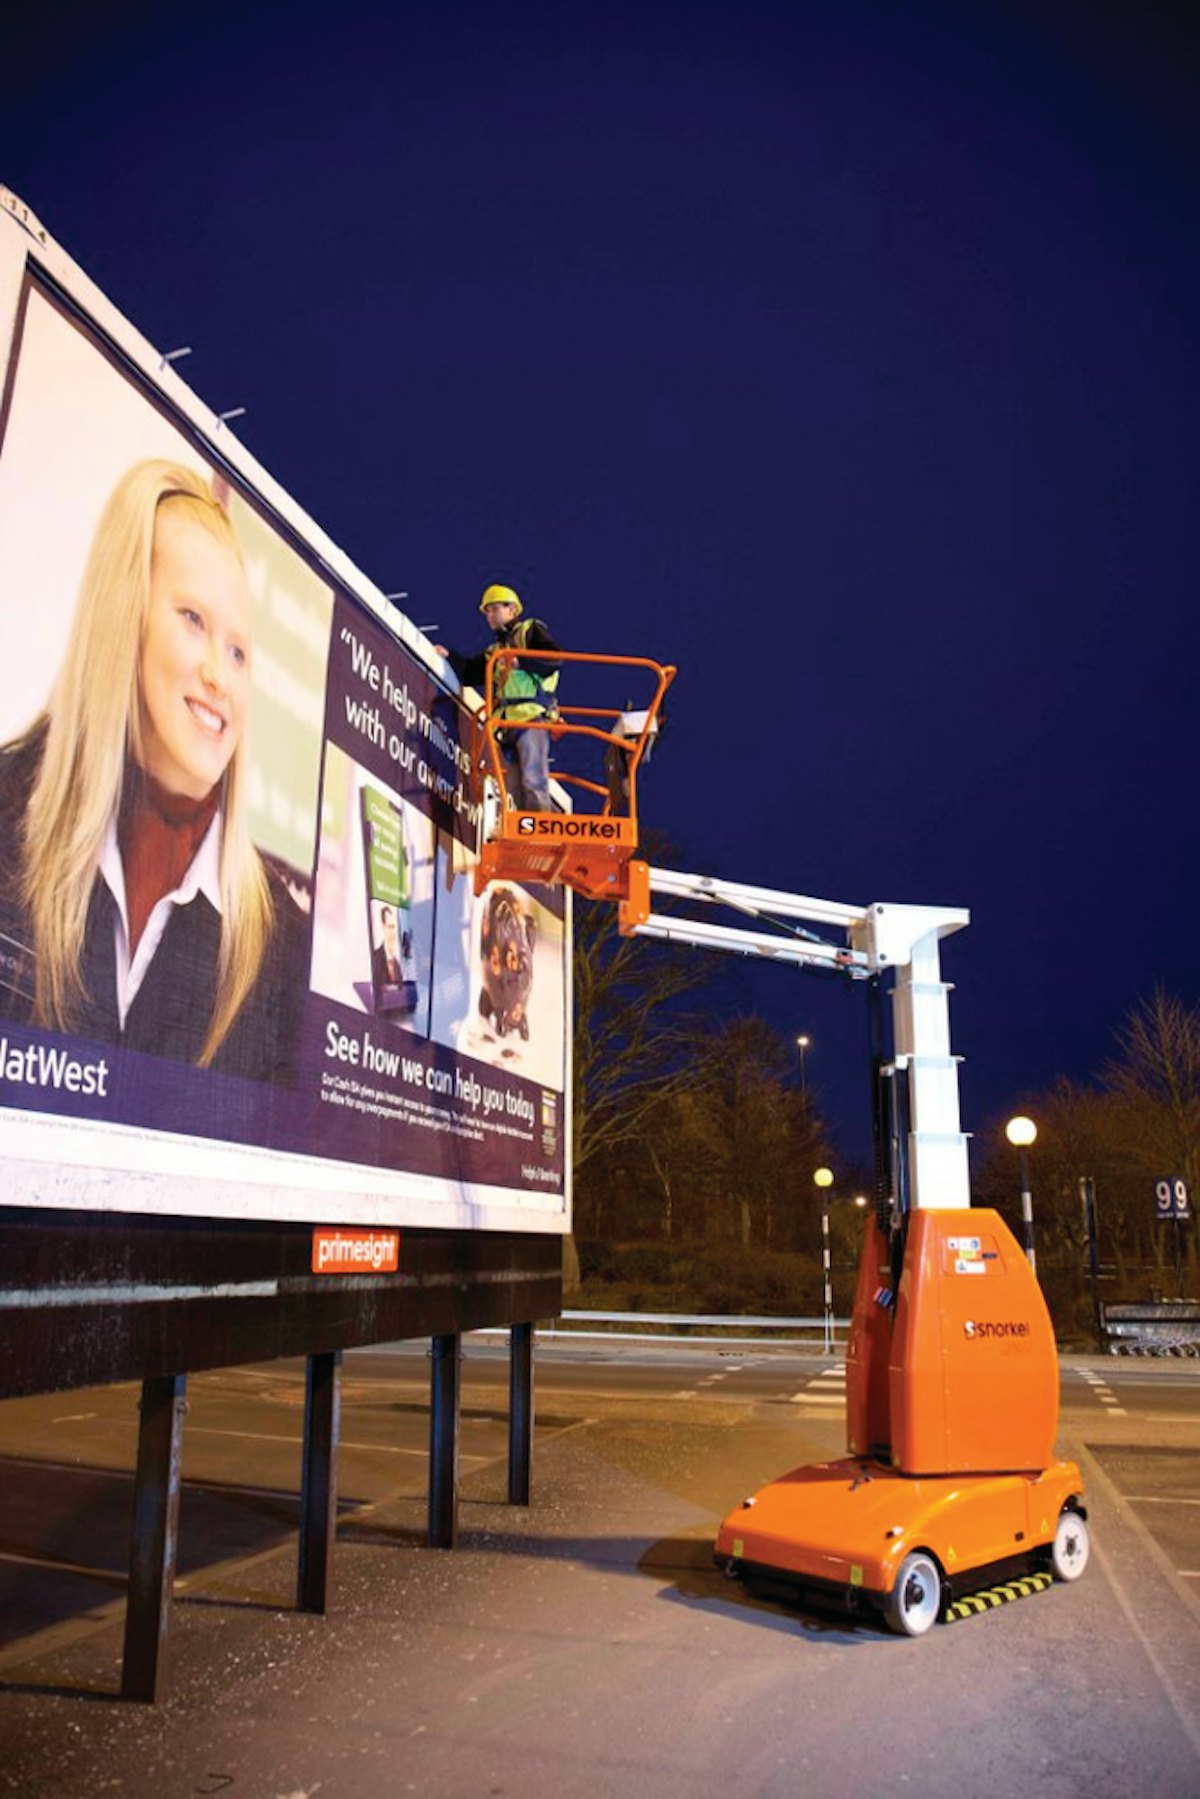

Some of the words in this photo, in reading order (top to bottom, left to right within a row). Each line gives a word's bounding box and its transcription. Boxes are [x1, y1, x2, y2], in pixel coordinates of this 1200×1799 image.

[382, 665, 417, 729] help
[344, 695, 385, 750] with
[389, 735, 416, 773] our
[538, 820, 620, 839] snorkel
[325, 1021, 359, 1065] See
[363, 1032, 400, 1078] how
[401, 1057, 424, 1087] we
[426, 1067, 453, 1096] can
[455, 1067, 481, 1112] help
[483, 1087, 505, 1117] you
[506, 1088, 536, 1129] today
[318, 1232, 395, 1270] primesight
[977, 1322, 1029, 1337] snorkel
